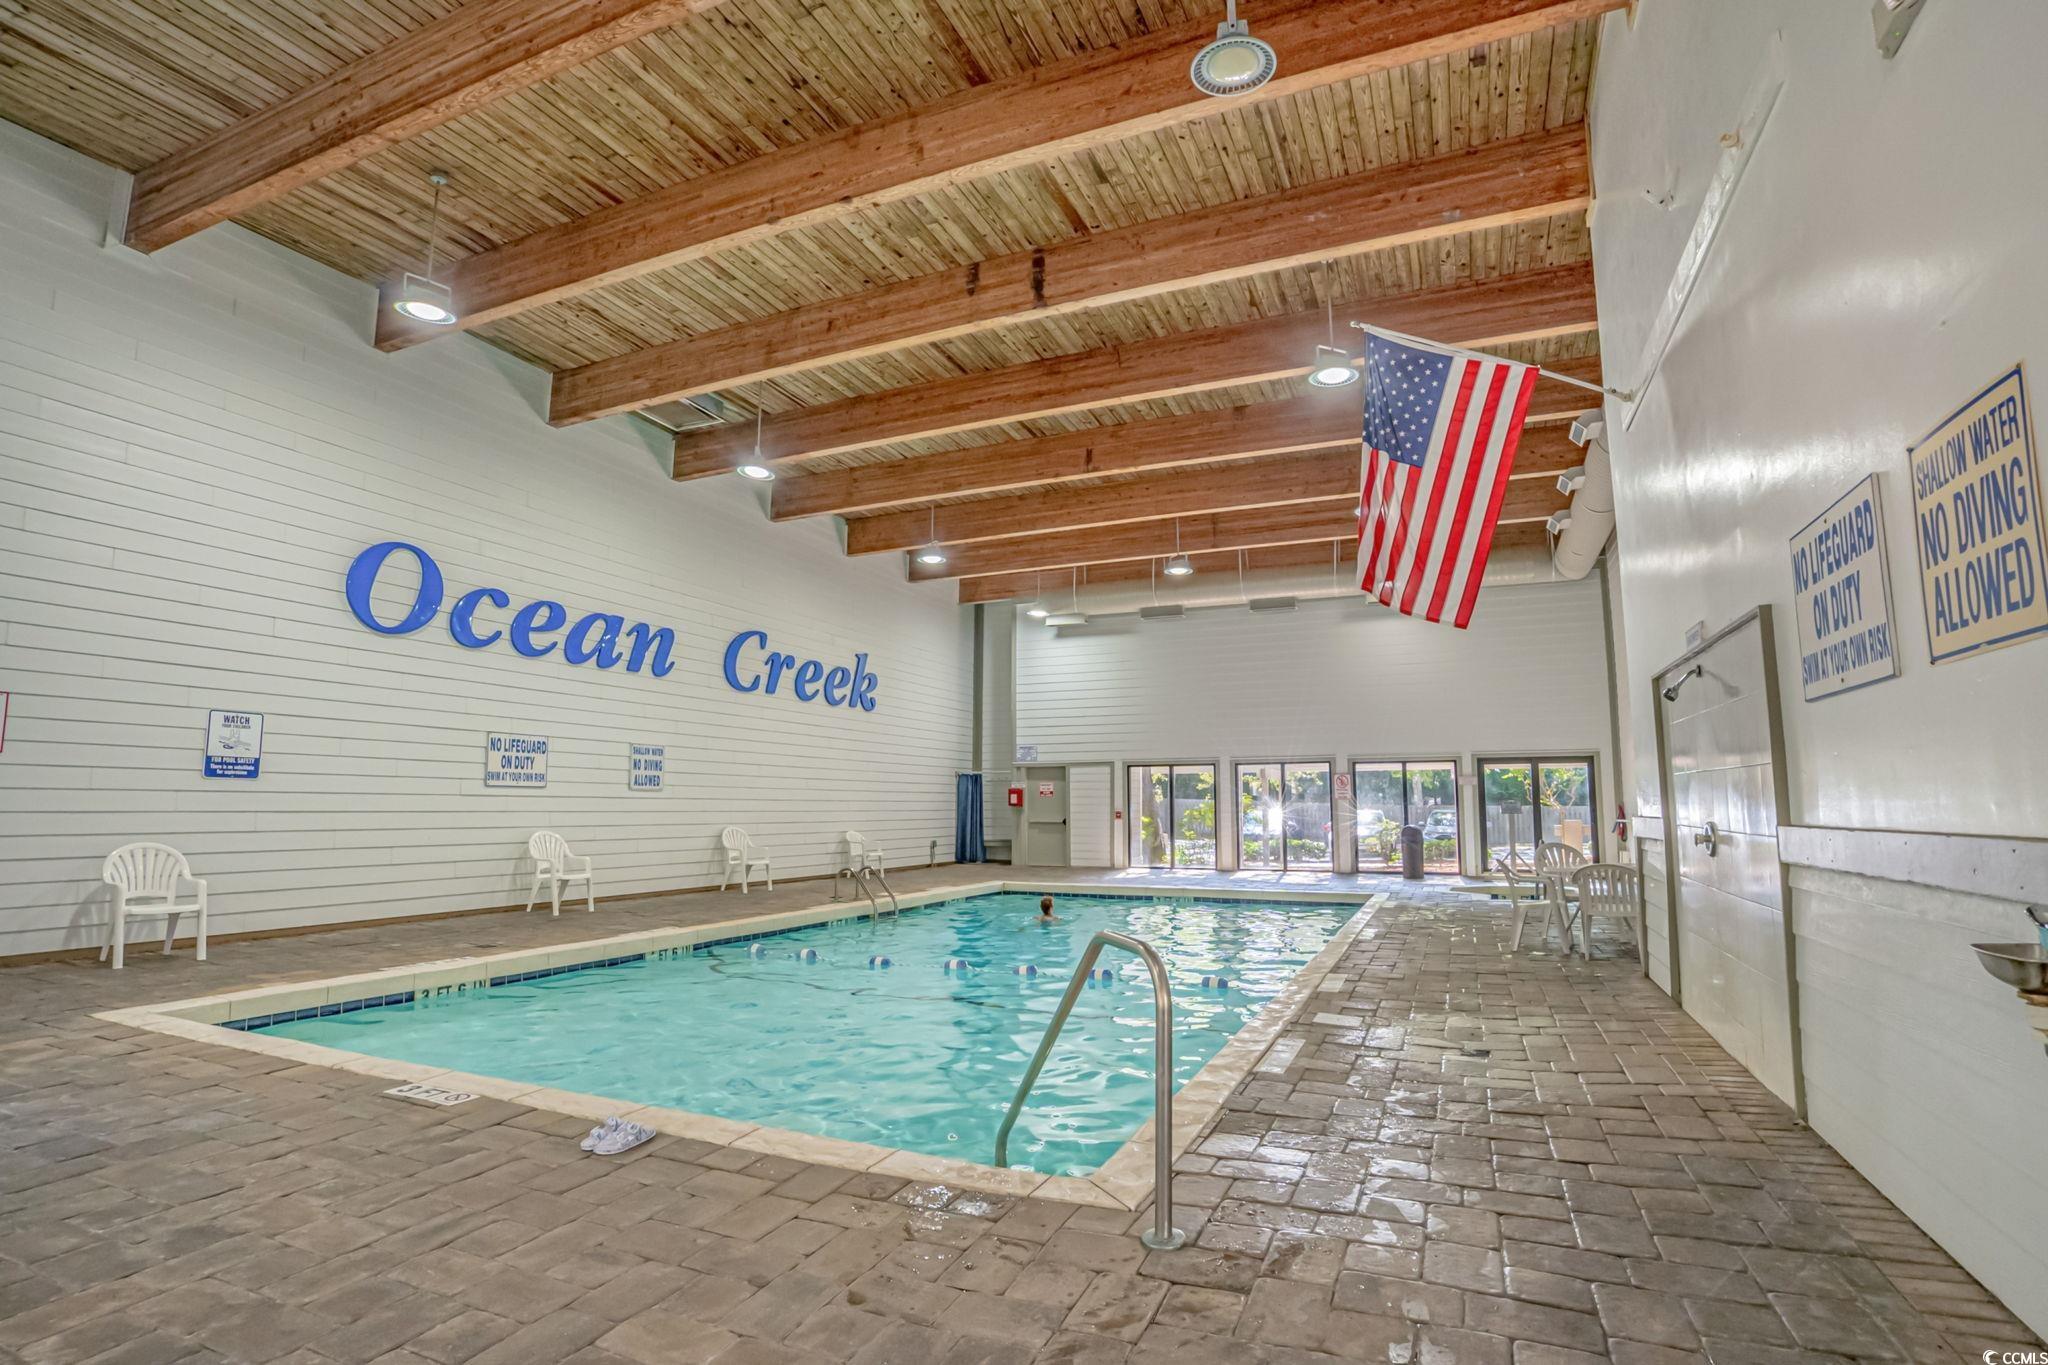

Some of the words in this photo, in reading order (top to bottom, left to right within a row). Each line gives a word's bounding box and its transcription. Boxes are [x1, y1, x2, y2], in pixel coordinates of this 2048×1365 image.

[1915, 429, 1968, 500] SHALLOW
[1968, 395, 2020, 465] WATER
[1921, 501, 1950, 570] NO
[1953, 456, 2028, 554] DIVING
[1792, 546, 1809, 596] NO
[1808, 499, 1875, 586] LIFEGUARD
[1935, 536, 2036, 637] ALLOWED
[1813, 588, 1831, 640] ON
[1830, 569, 1862, 632] DUTY
[346, 541, 676, 678] Ocean
[724, 629, 879, 712] Creek
[1802, 651, 1821, 686] SWIM
[1820, 647, 1830, 680] AT
[1828, 640, 1851, 676] YOUR
[1849, 632, 1869, 670] OWN
[1868, 622, 1891, 663] RISK
[223, 714, 250, 725] WATCH
[490, 736, 502, 752] NO
[503, 738, 547, 755] LIFEGUARD
[633, 746, 650, 755] SHALLOW
[501, 755, 512, 769] ON
[514, 756, 535, 770] DUTY
[633, 758, 642, 770] NO
[643, 759, 663, 772] DIVING
[487, 771, 501, 781] SWIM
[502, 771, 509, 781] AT
[508, 772, 522, 782] YOUR
[633, 774, 661, 787] ALLOWED
[436, 985, 453, 997] FT
[473, 979, 487, 989] IN
[396, 1084, 423, 1093] 3
[413, 1088, 452, 1098] FT
